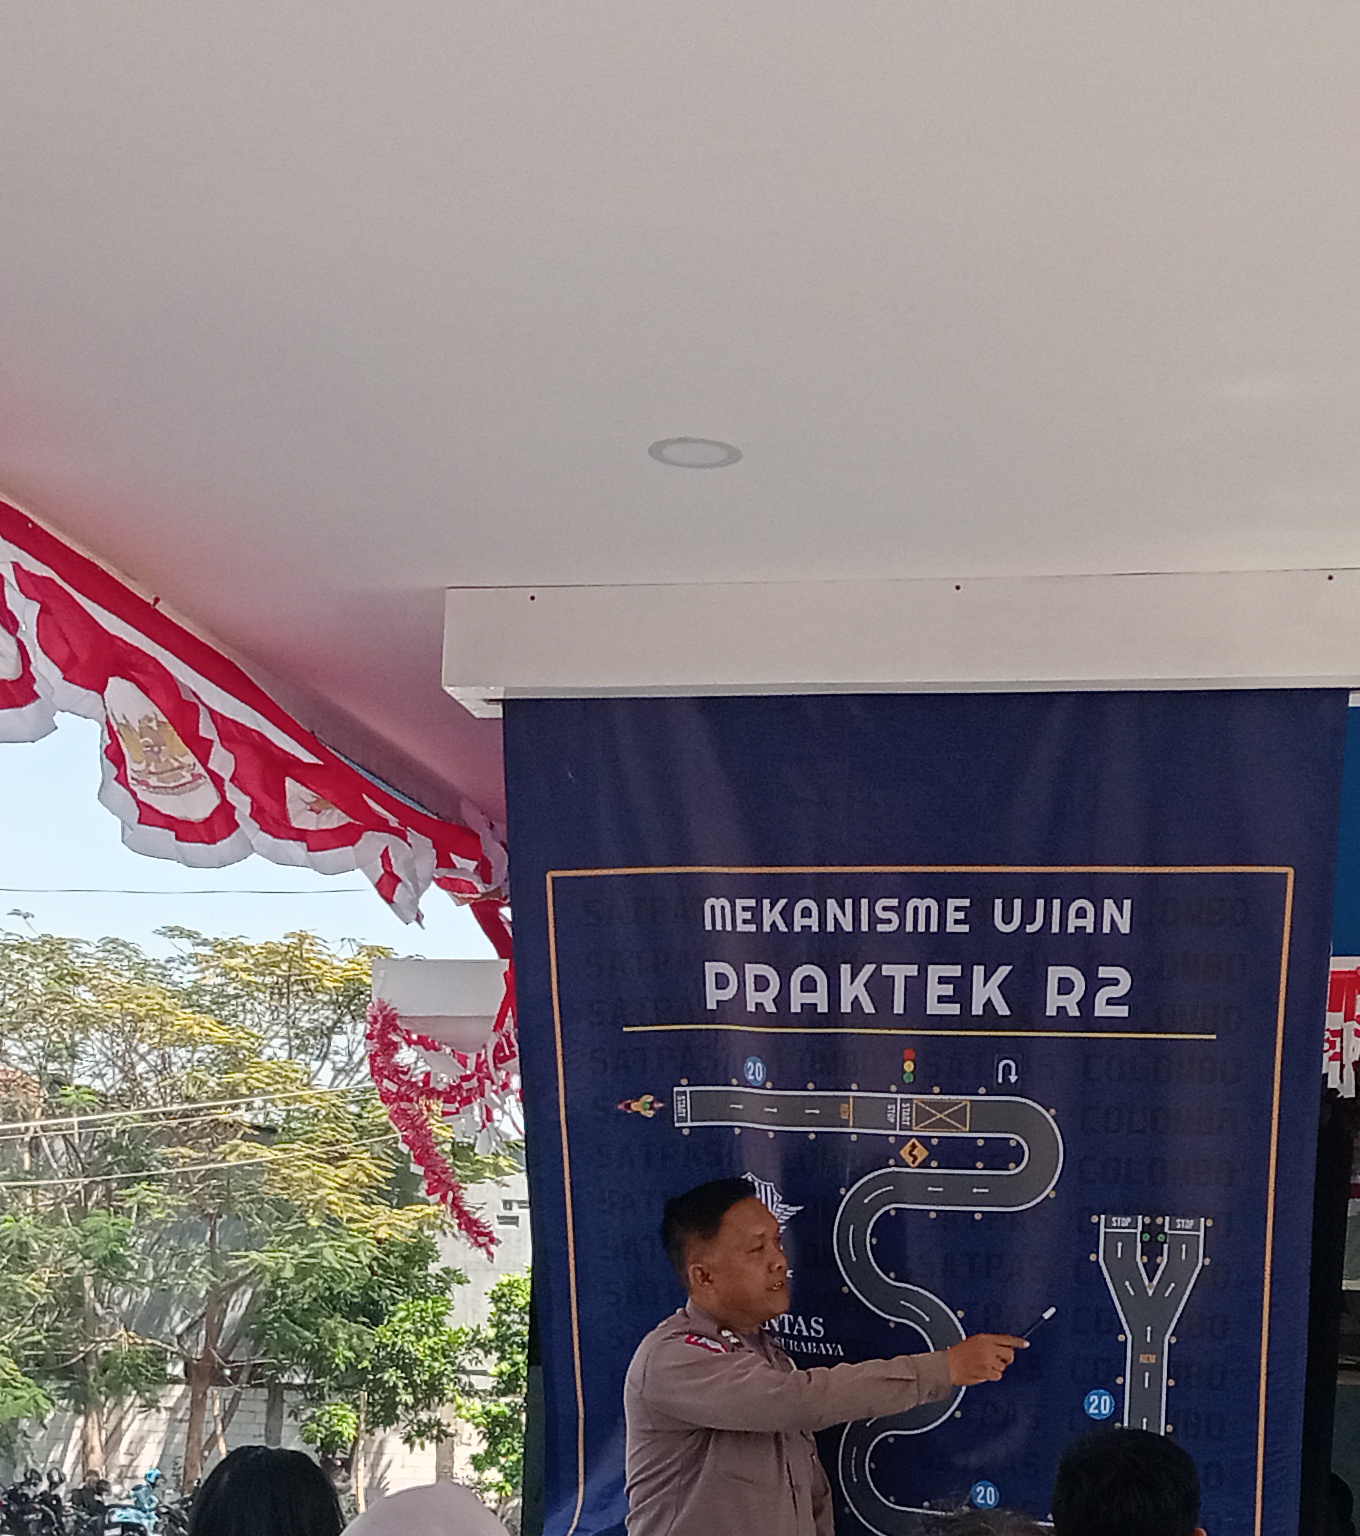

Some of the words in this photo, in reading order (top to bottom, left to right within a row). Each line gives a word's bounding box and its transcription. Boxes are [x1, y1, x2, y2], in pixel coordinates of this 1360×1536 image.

[703, 896, 970, 934] MEKANISME
[992, 898, 1133, 935] UJIAN
[703, 960, 1012, 1017] PRAKTEK
[1045, 965, 1133, 1018] R2
[747, 1062, 764, 1081] 20
[887, 1104, 896, 1123] STOP
[1111, 1216, 1132, 1227] STOP
[1175, 1219, 1194, 1229] STOP
[759, 1312, 825, 1338] NTAS
[1089, 1395, 1111, 1415] 20
[976, 1485, 996, 1505] 20
